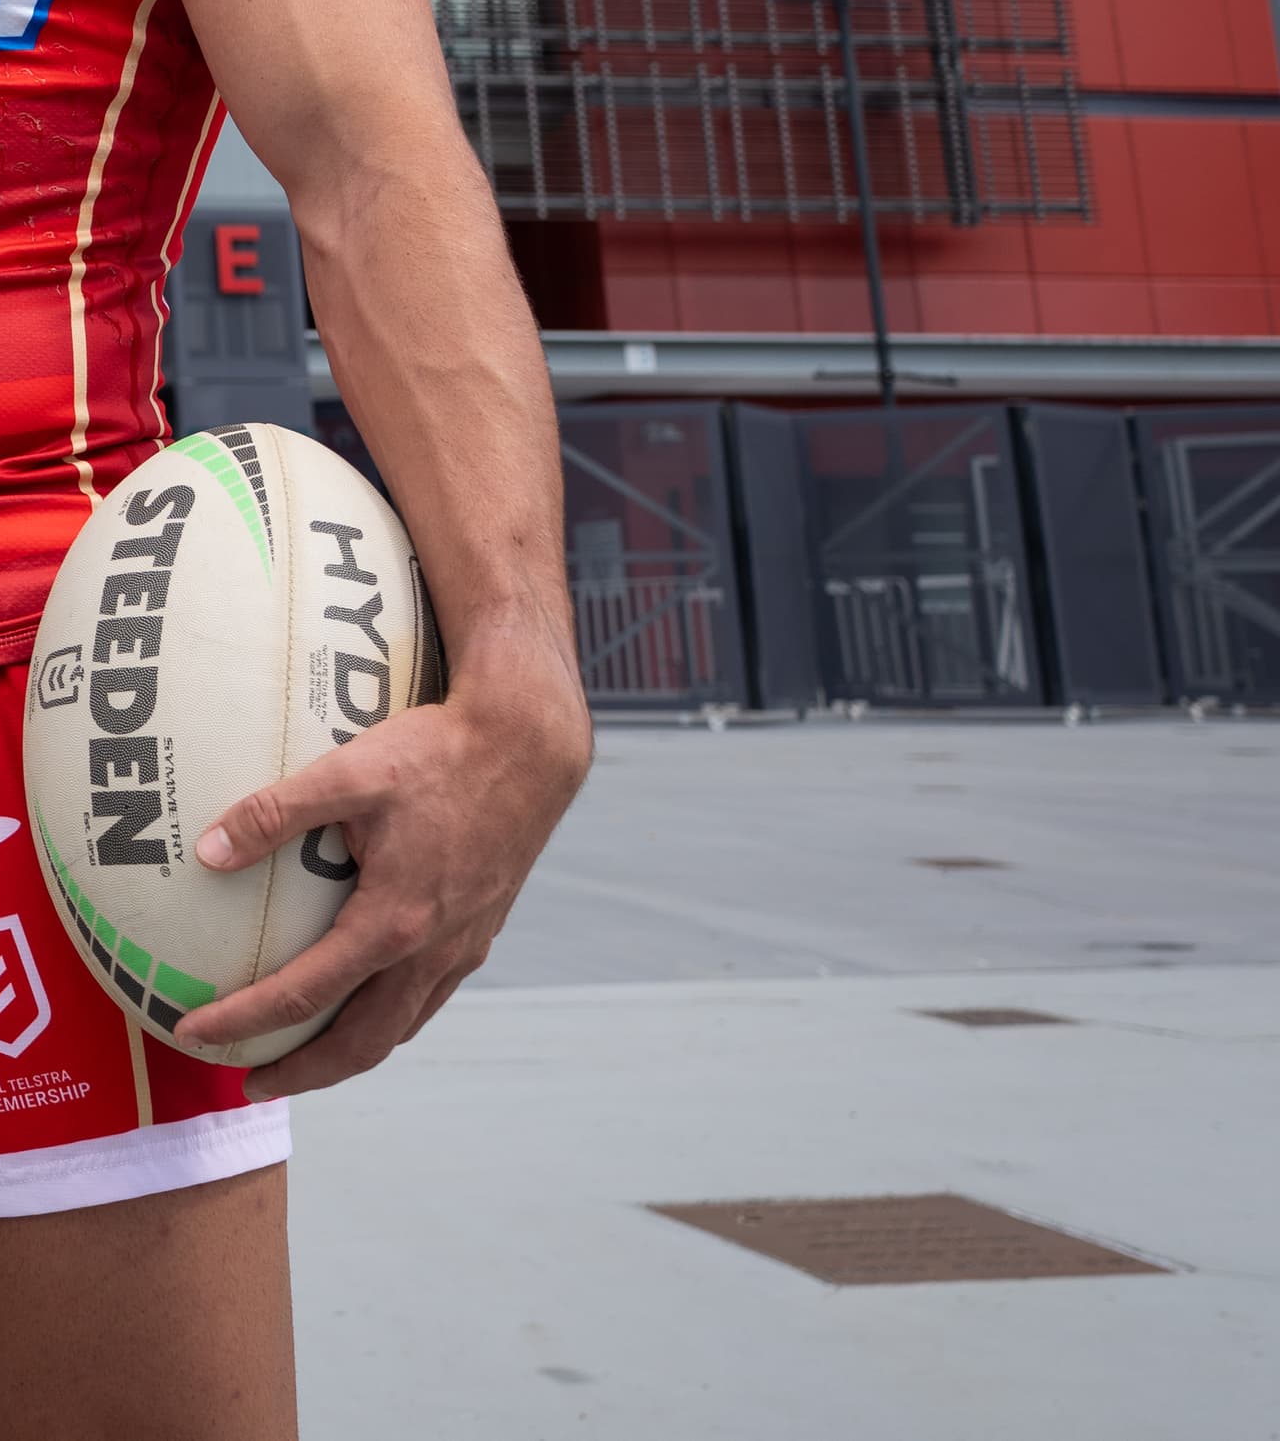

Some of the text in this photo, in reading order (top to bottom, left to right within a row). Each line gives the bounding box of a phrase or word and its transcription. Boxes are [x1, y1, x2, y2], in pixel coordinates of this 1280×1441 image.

[215, 223, 265, 295] E
[88, 484, 196, 866] STEEDEN
[300, 520, 390, 881] HYDO
[8, 1069, 72, 1092] TELSTRA
